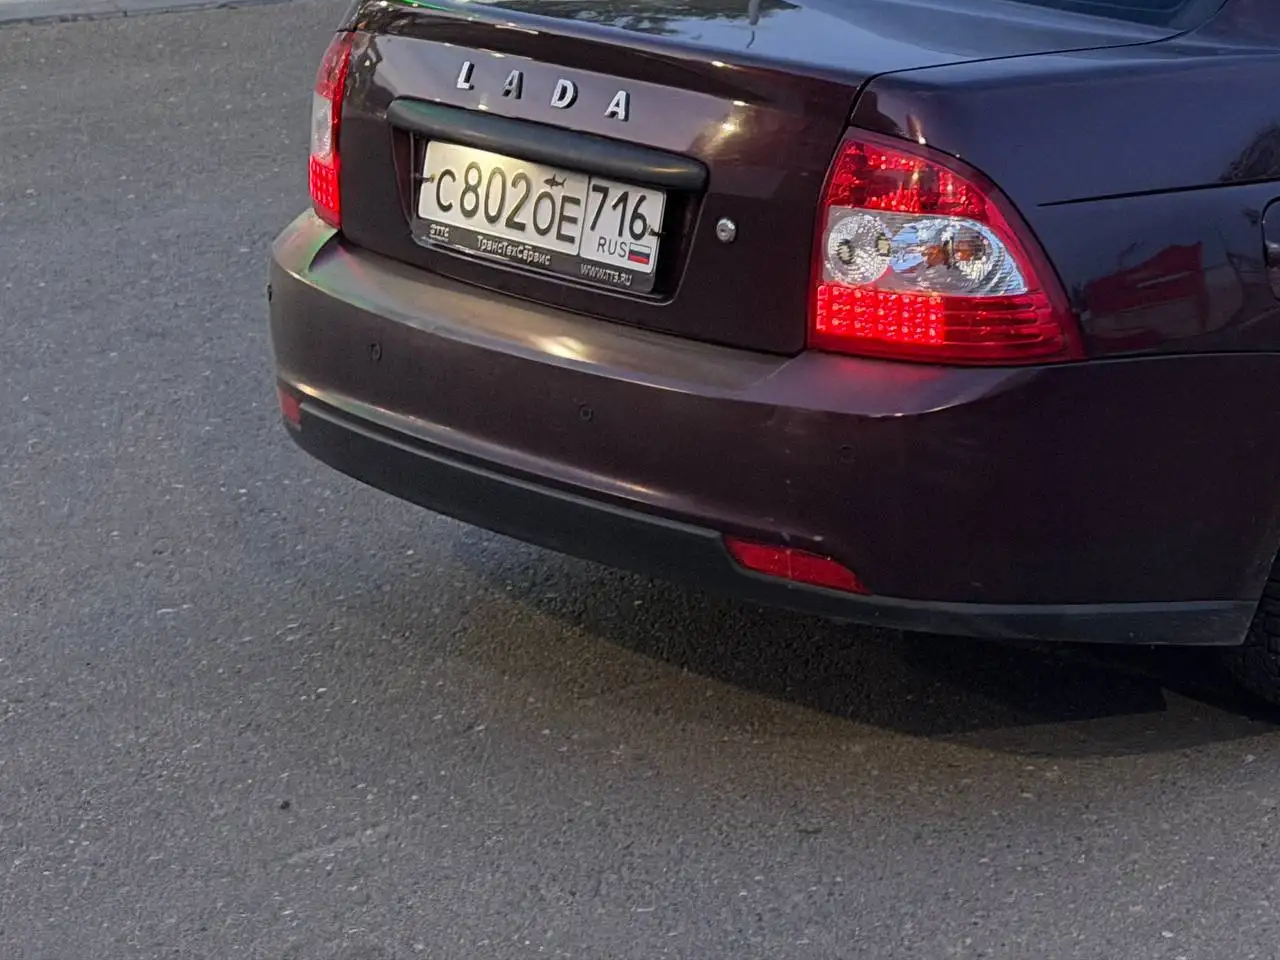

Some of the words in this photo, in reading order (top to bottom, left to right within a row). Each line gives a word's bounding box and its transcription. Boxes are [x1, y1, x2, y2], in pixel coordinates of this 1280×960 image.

[456, 60, 631, 121] LADA
[590, 185, 648, 241] 716
[476, 234, 552, 266] ТрансТехСервис
[597, 236, 628, 258] RUS
